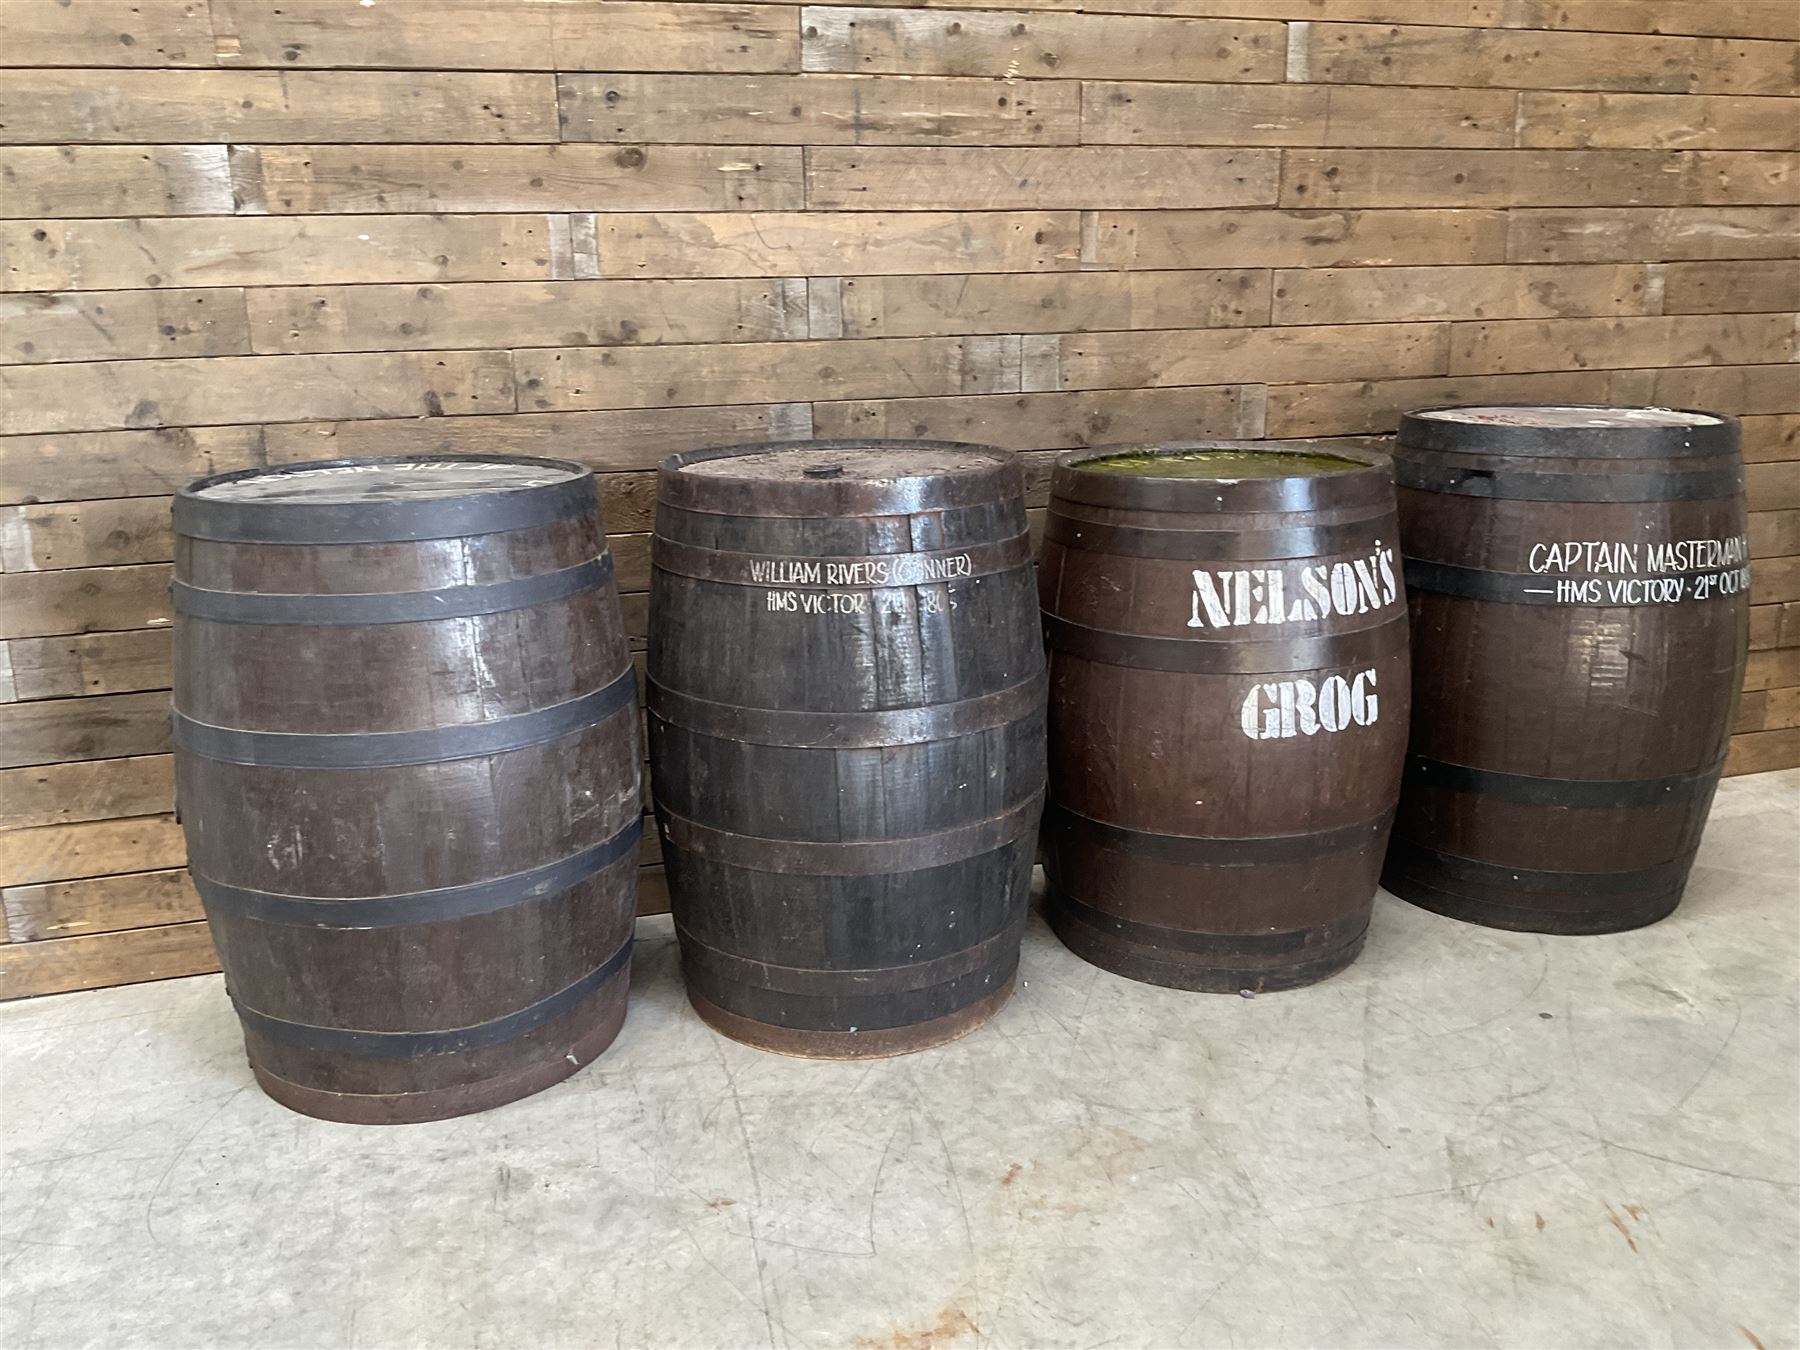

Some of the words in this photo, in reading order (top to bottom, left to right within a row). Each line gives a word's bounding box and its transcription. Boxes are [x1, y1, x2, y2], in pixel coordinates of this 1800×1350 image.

[1529, 541, 1638, 574] CAPTAIN
[1647, 536, 1743, 573] MASTERMAN
[748, 559, 821, 584] WILLIAM
[827, 561, 890, 584] RIVERS
[1187, 539, 1396, 628] NELSON'S
[766, 590, 798, 612] HMS
[800, 593, 871, 614] VICTOR
[1607, 577, 1685, 604] VICTORY
[1241, 668, 1379, 740] GROG
